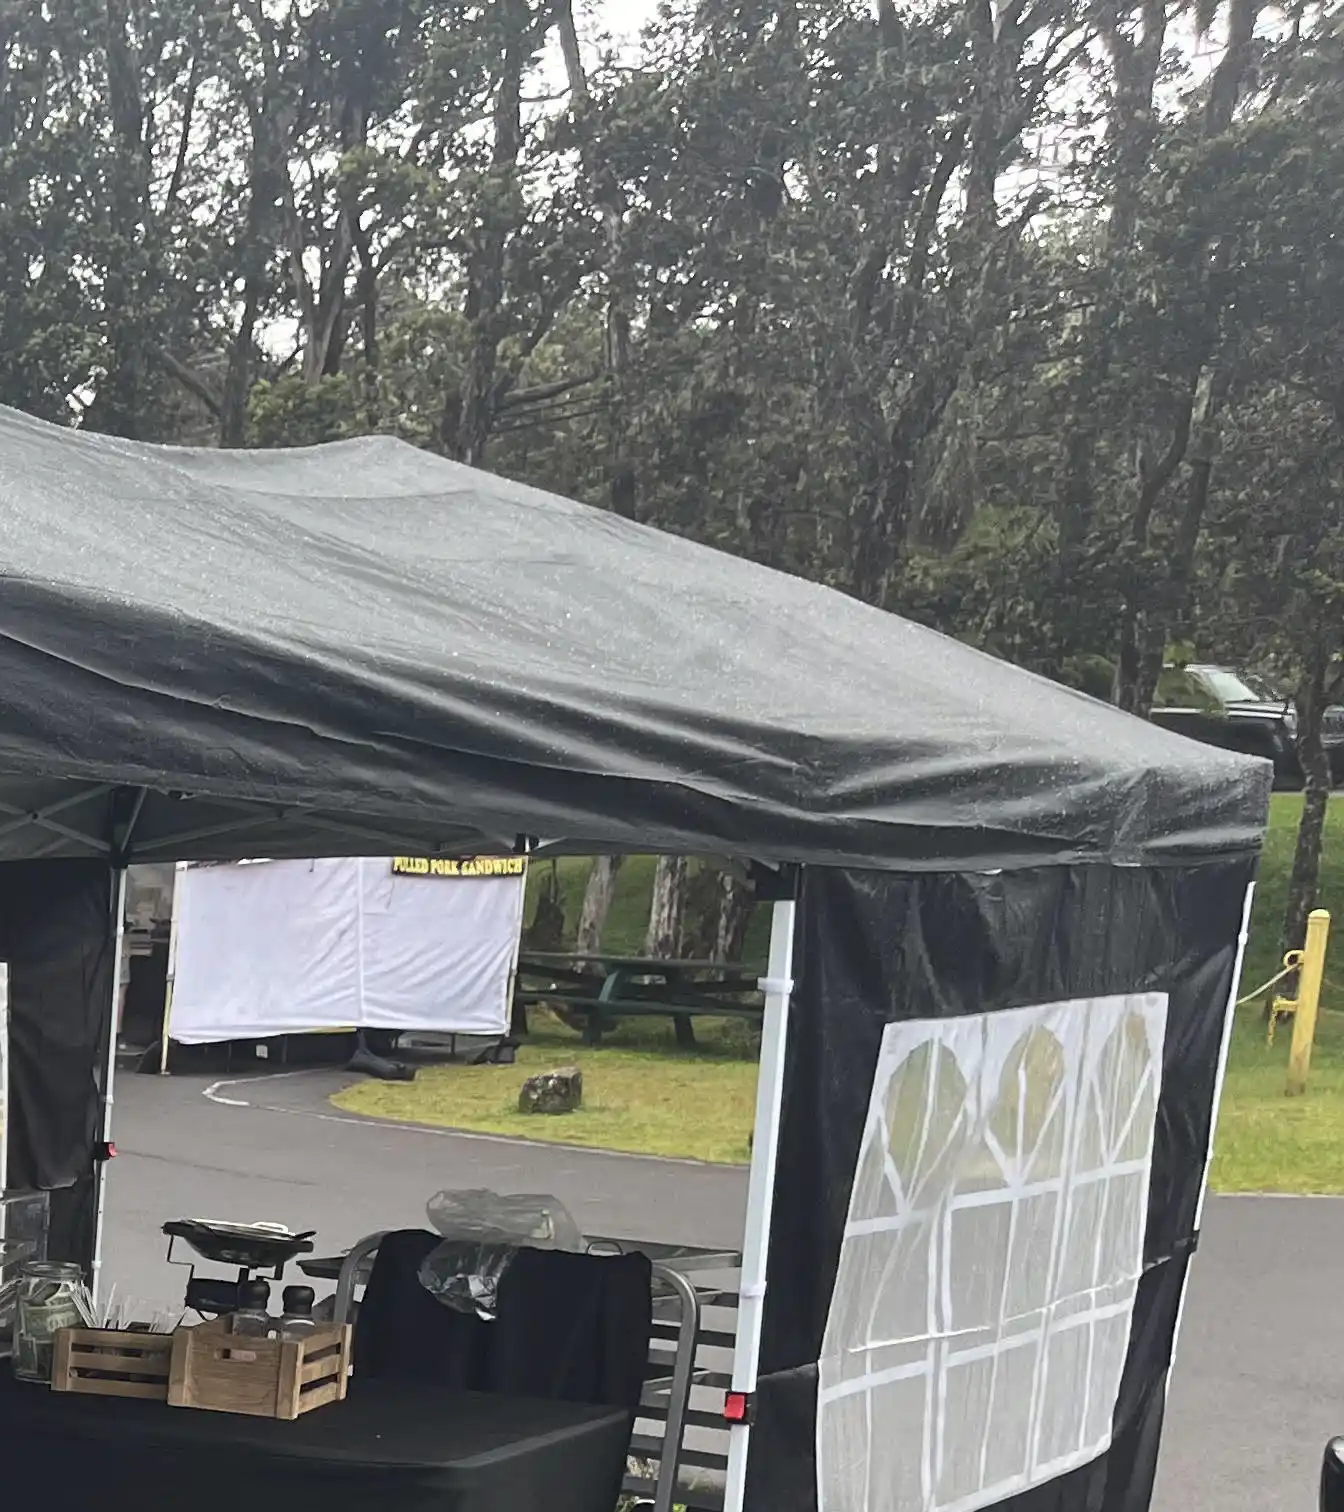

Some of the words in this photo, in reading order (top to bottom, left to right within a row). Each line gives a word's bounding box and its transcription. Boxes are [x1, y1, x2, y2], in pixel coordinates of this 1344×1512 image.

[393, 856, 430, 874] PULLED
[430, 858, 459, 875] PORK
[461, 858, 523, 876] SANDWICH
